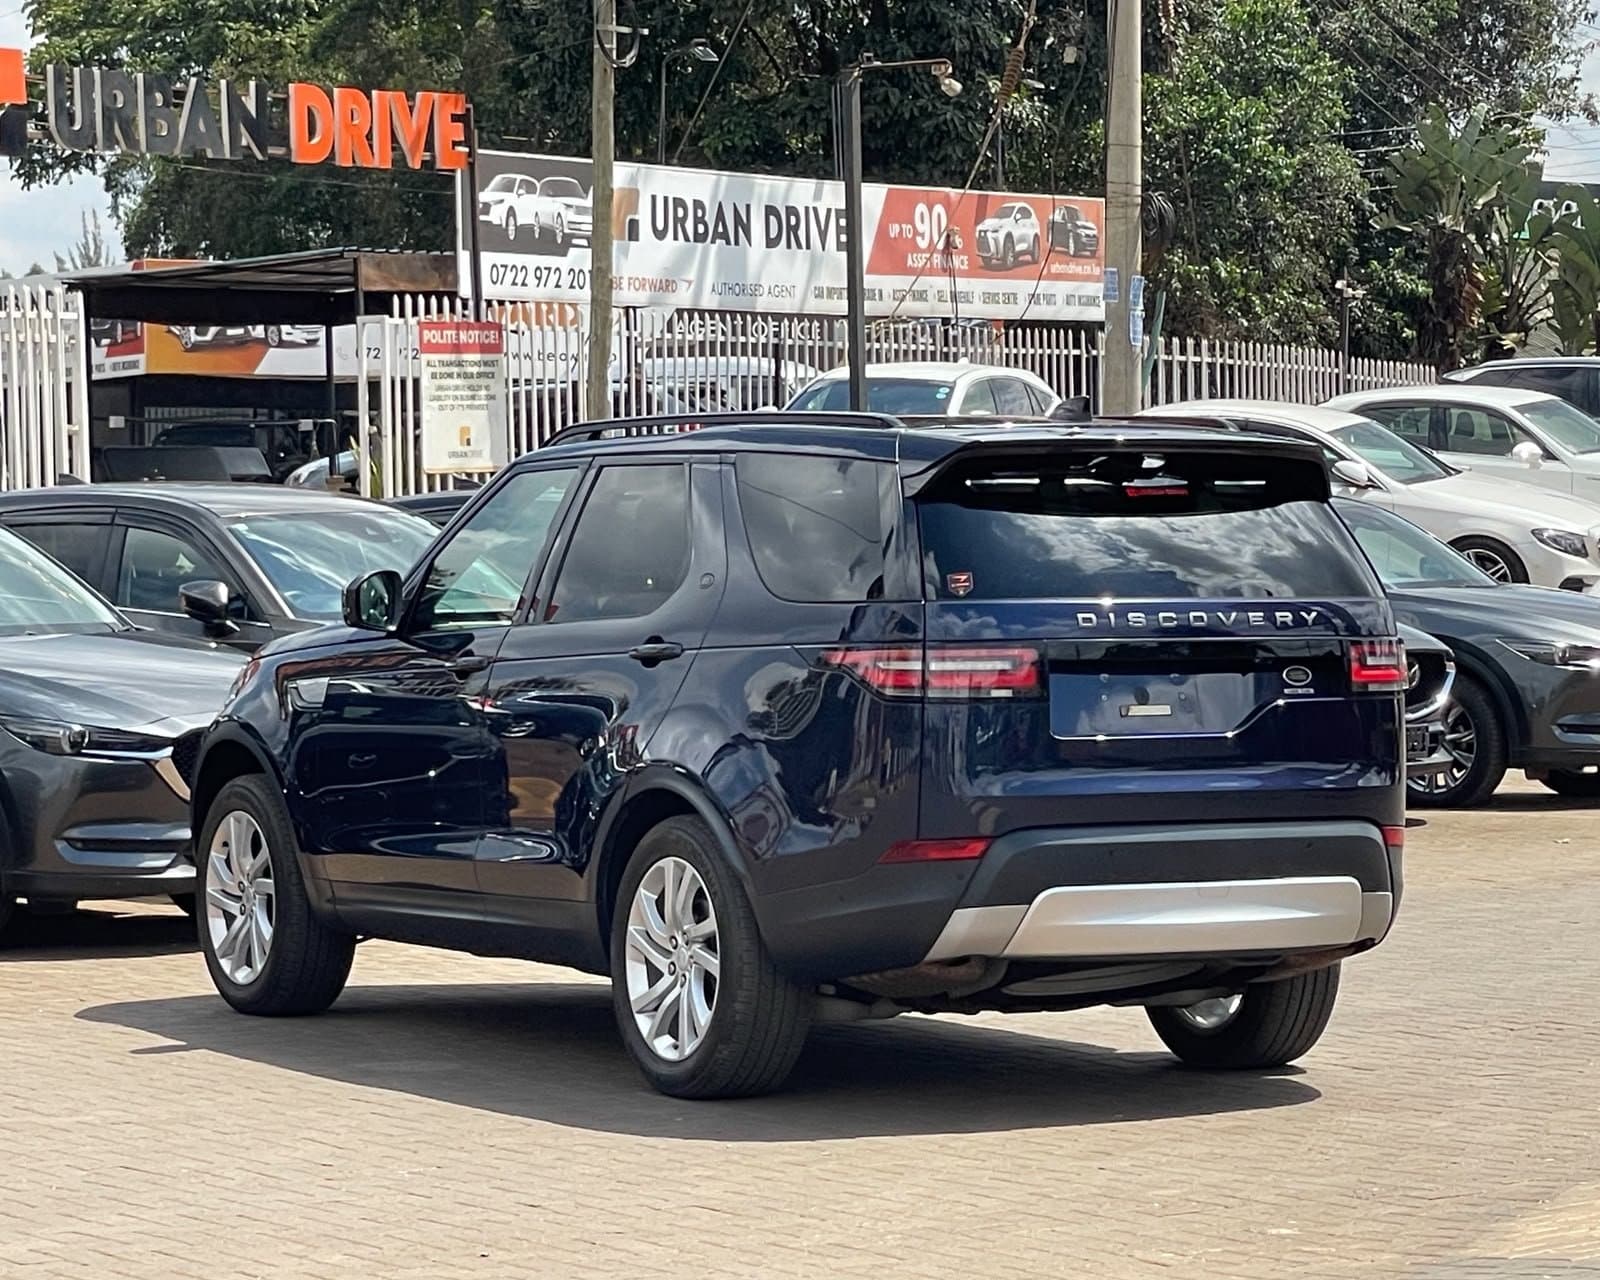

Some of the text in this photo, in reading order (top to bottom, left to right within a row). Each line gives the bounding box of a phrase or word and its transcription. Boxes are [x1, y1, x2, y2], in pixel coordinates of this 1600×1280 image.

[46, 63, 468, 170] URBAN DRIVE
[651, 194, 848, 252] URBAN DRIVE
[889, 223, 900, 238] UP
[900, 224, 914, 238] TO
[907, 252, 969, 270] ASSET FINANCE
[490, 263, 529, 287] 0722
[534, 266, 562, 289] 972
[612, 276, 678, 294] BE FORWARD
[711, 281, 797, 299] AUTHORISED AGENT
[423, 329, 500, 345] POLITE NOTICE!
[426, 360, 437, 368] ALL
[1076, 611, 1318, 628] DISCOVERY
